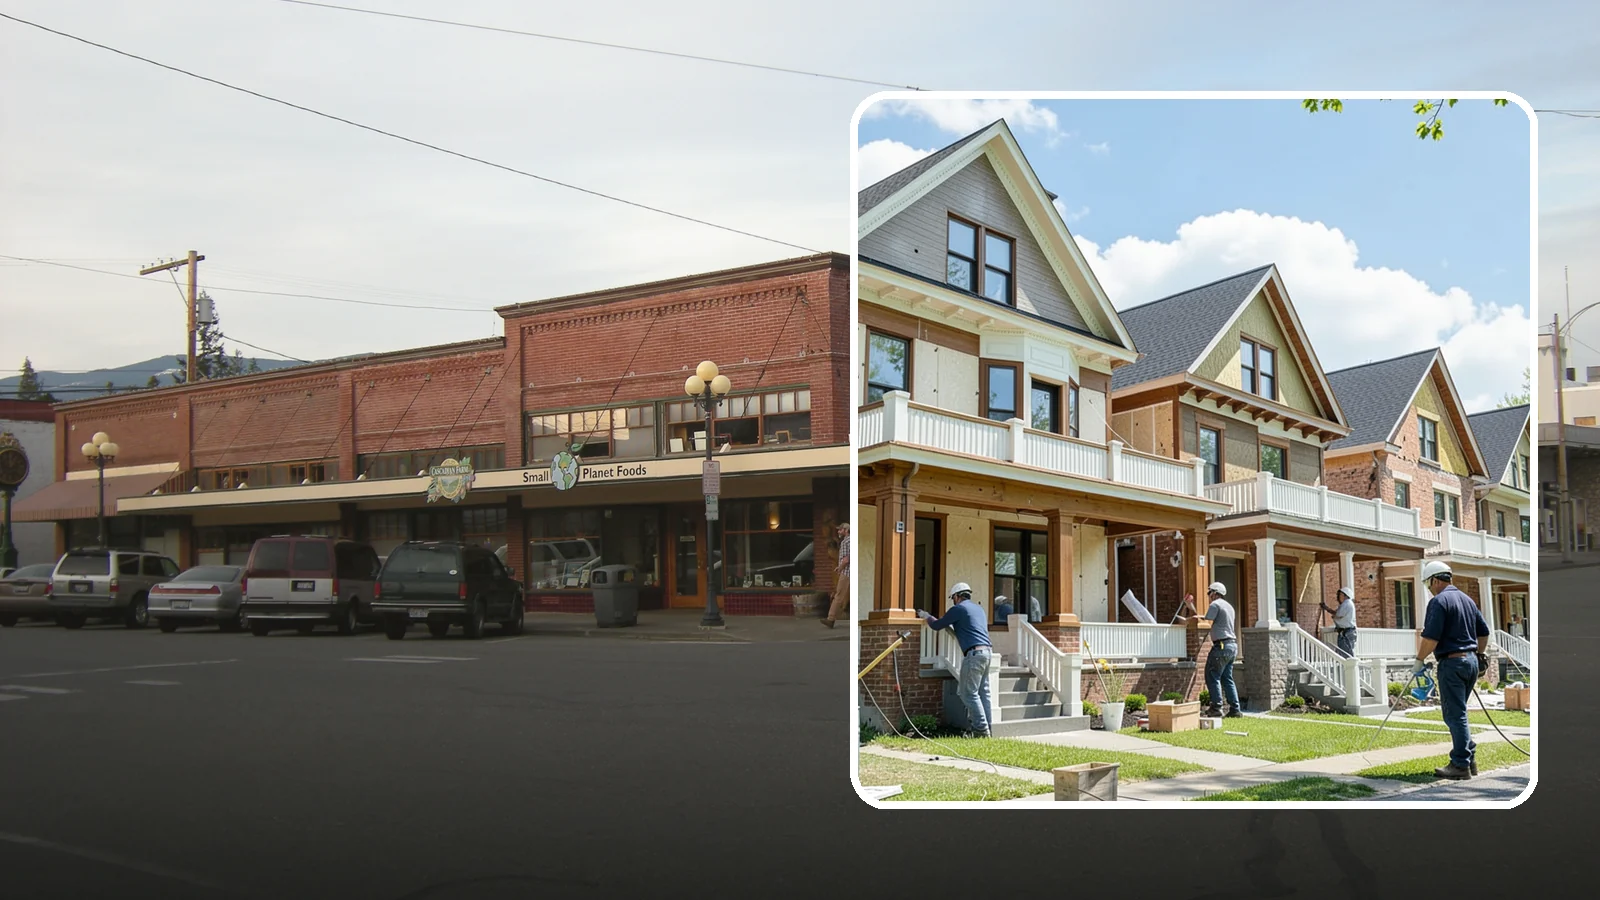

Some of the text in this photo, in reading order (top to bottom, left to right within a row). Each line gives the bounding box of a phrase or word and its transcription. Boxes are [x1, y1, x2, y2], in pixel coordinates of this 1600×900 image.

[523, 464, 647, 483] Small Planet Foods
